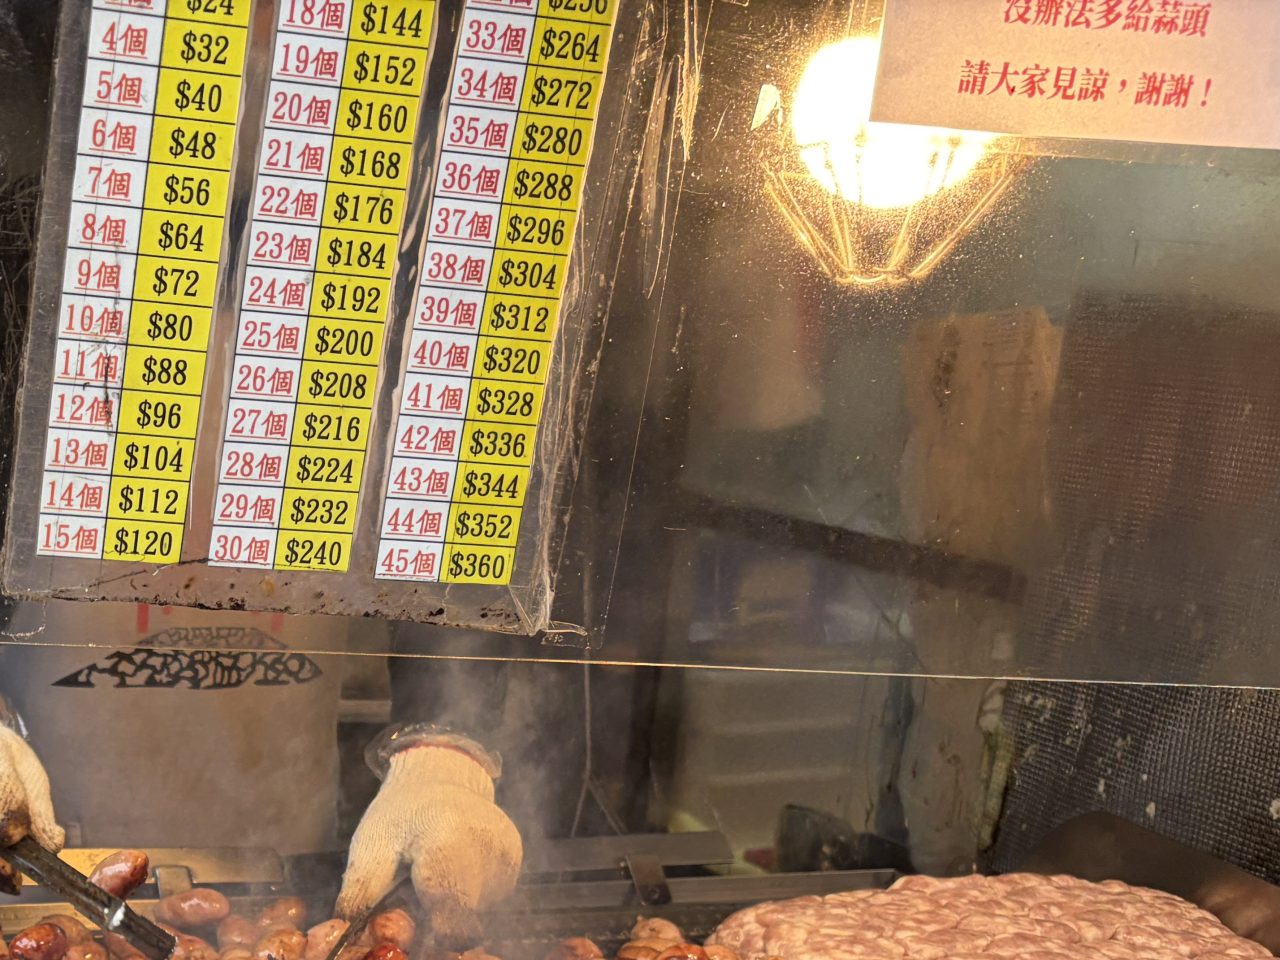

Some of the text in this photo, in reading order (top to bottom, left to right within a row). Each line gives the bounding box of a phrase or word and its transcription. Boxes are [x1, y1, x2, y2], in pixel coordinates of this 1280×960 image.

[286, 0, 421, 37] 18個 $144
[1003, 0, 1212, 38] 沒辦法多給蒜頭
[101, 22, 228, 64] 4個 $32
[465, 18, 599, 62] 33個 $264
[280, 43, 415, 85] 19個 $152
[96, 72, 221, 112] 5個 $40
[456, 66, 591, 109] 34個 $272
[957, 59, 1213, 109] 請大家見諒，謝謝！
[271, 91, 407, 132] 20個 $160
[91, 118, 216, 159] 6個 $48
[448, 114, 582, 155] 35個 $280
[265, 137, 400, 179] 21個 $168
[88, 165, 209, 205] 7個 $56
[441, 160, 572, 201] 36個 $288
[258, 184, 393, 224] 22個 $176
[80, 212, 203, 251] 8個 $64
[434, 206, 564, 245] 37個 $296
[253, 230, 385, 269] 23個 $184
[77, 258, 198, 296] 9個 $72
[427, 251, 556, 289] 38個 $304
[247, 274, 380, 313] 24個 $192
[65, 302, 192, 341] 10個 $80
[419, 295, 548, 332] 39個 $312
[241, 319, 373, 356] 25個 $200
[413, 339, 540, 374] 40個 $320
[61, 349, 187, 385] 11個 $88
[236, 364, 366, 399] 26個 $208
[56, 392, 180, 428] 12個 $96
[406, 382, 533, 416] 41個 $328
[230, 407, 359, 441] 27個 $216
[400, 424, 525, 457] 42個 $336
[53, 437, 182, 472] 13個 $104
[224, 450, 352, 483] 28個 $224
[46, 481, 178, 514] 14個 $112
[392, 466, 518, 498] 43個 $344
[219, 492, 347, 524] 29個 $232
[386, 507, 511, 538] 44個 $352
[42, 525, 172, 556] 15個 $120
[214, 534, 341, 565] 30個 $240
[381, 547, 504, 578] 45個 $360
